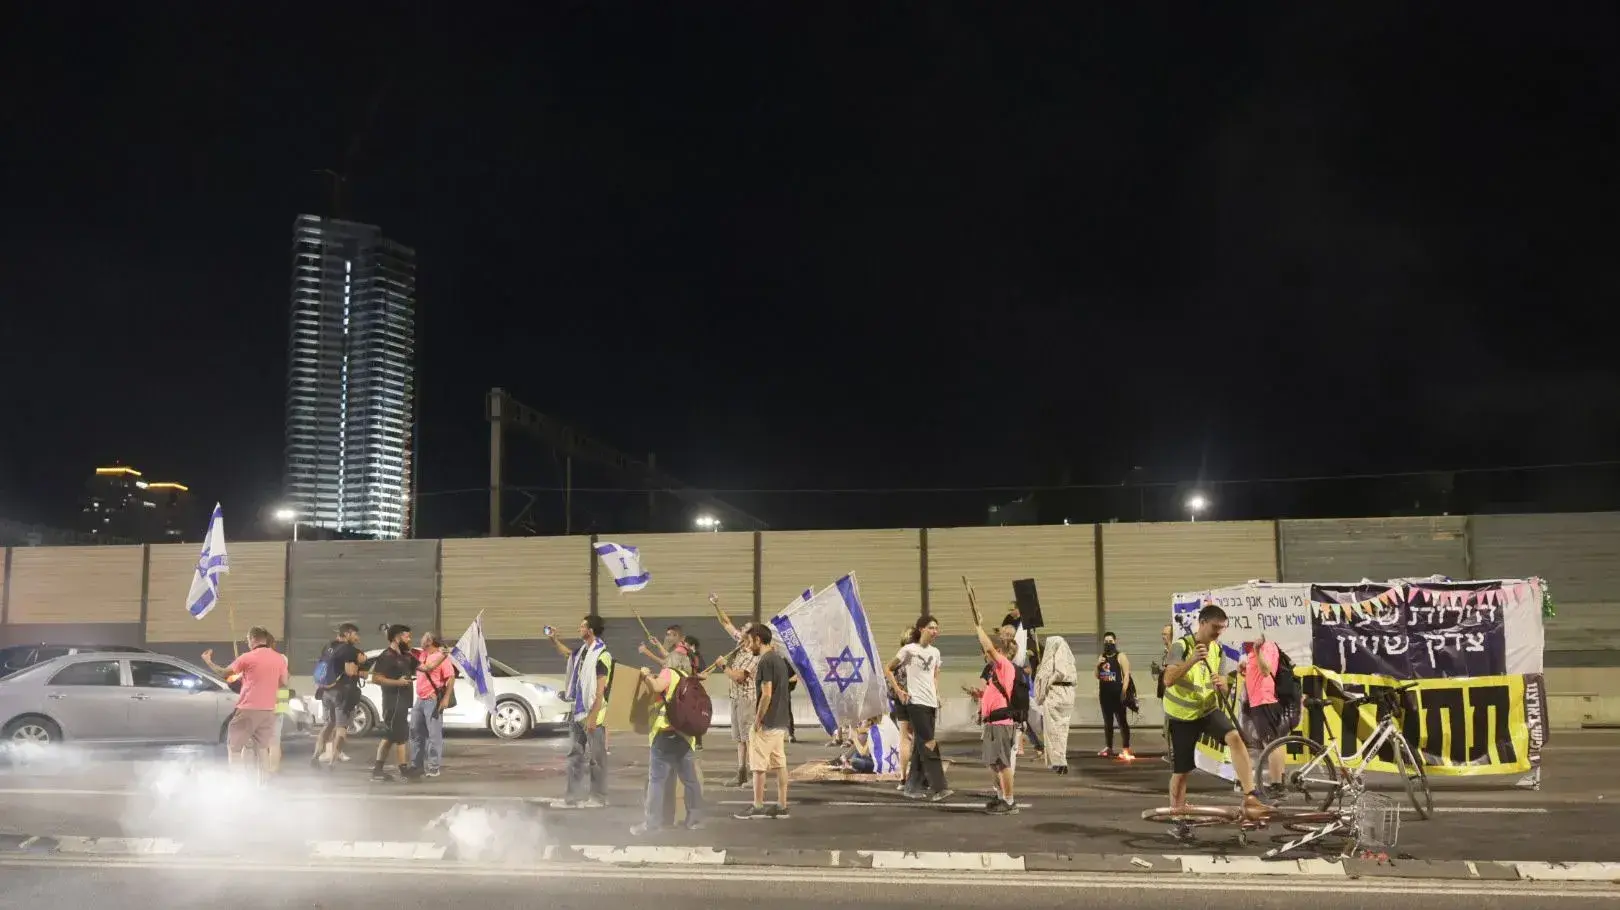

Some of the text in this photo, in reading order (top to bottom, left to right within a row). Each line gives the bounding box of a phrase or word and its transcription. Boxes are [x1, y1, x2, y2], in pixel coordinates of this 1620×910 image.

[1268, 594, 1288, 608] שלא
[1285, 612, 1306, 626] שלא
[1423, 632, 1485, 669] צדק
